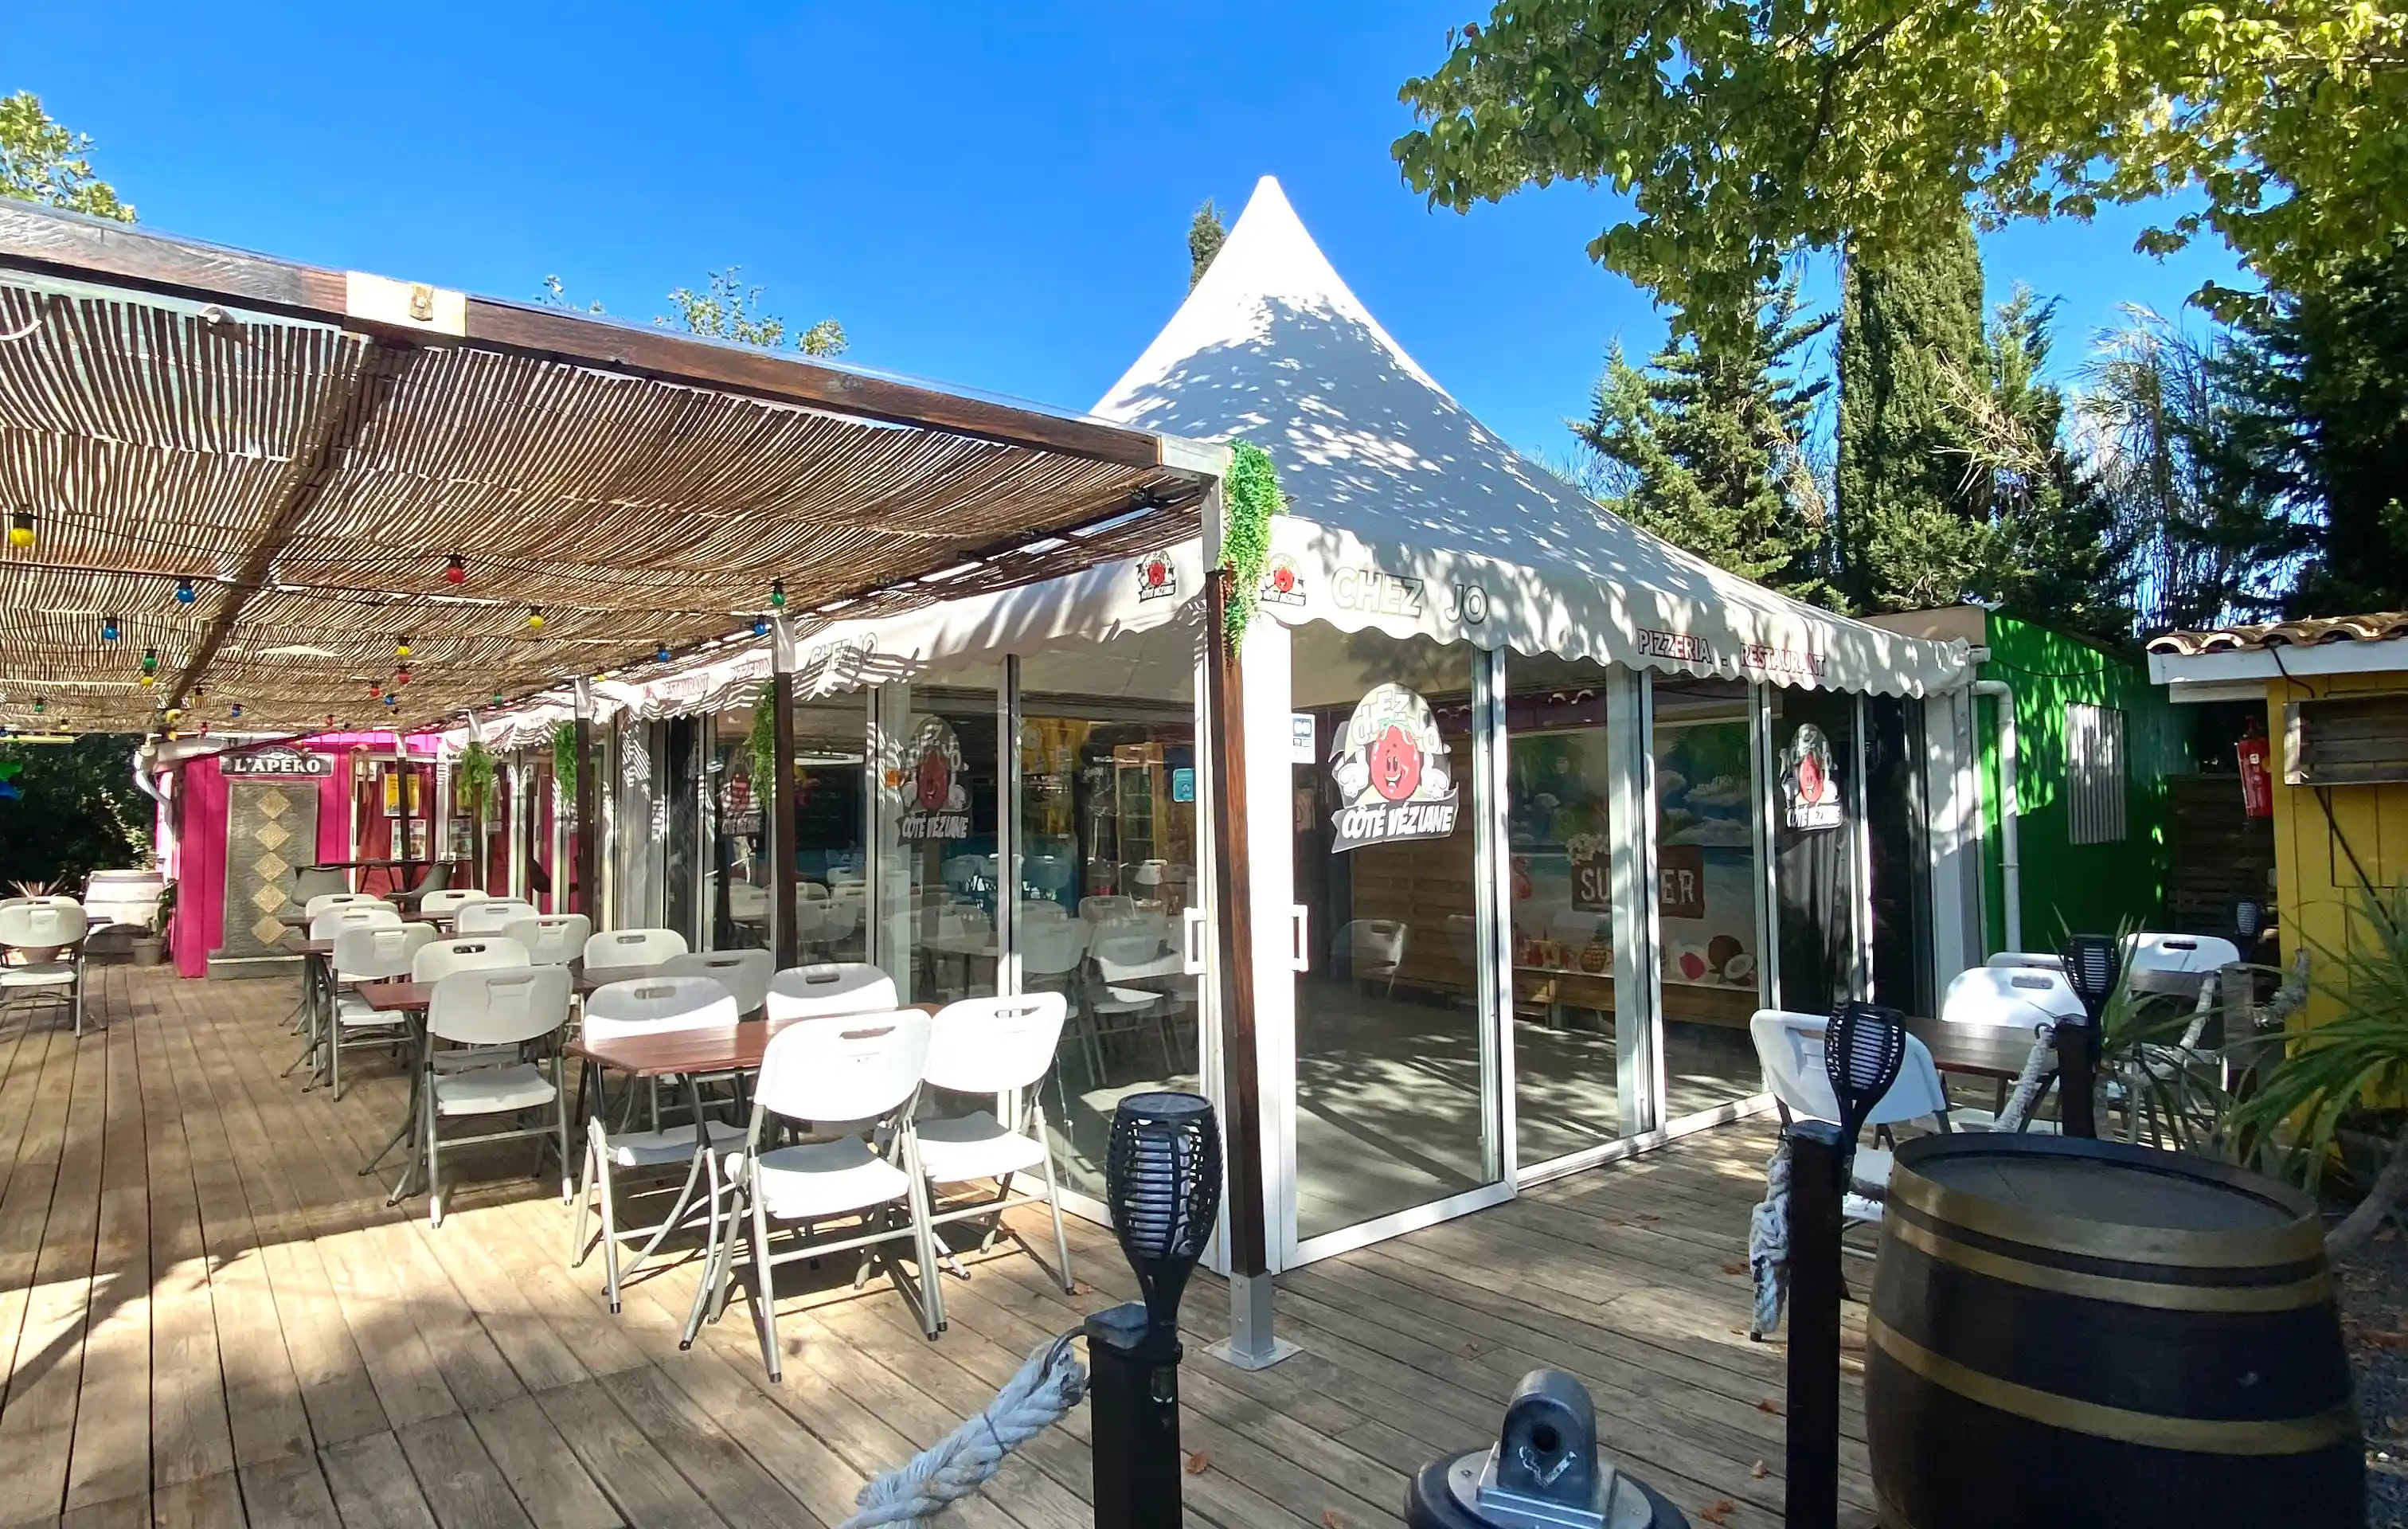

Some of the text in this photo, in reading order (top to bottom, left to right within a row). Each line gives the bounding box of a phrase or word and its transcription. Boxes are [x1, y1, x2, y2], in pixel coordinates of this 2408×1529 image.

[1331, 566, 1488, 625] CHEZ JO
[1637, 628, 1713, 663] PIZZERIA
[1740, 643, 1826, 676] RESTAURANT
[1351, 690, 1440, 754] CHEZ JO
[1342, 801, 1453, 839] CÔTÉ VÉZIANE
[1581, 866, 1695, 905] SUER
